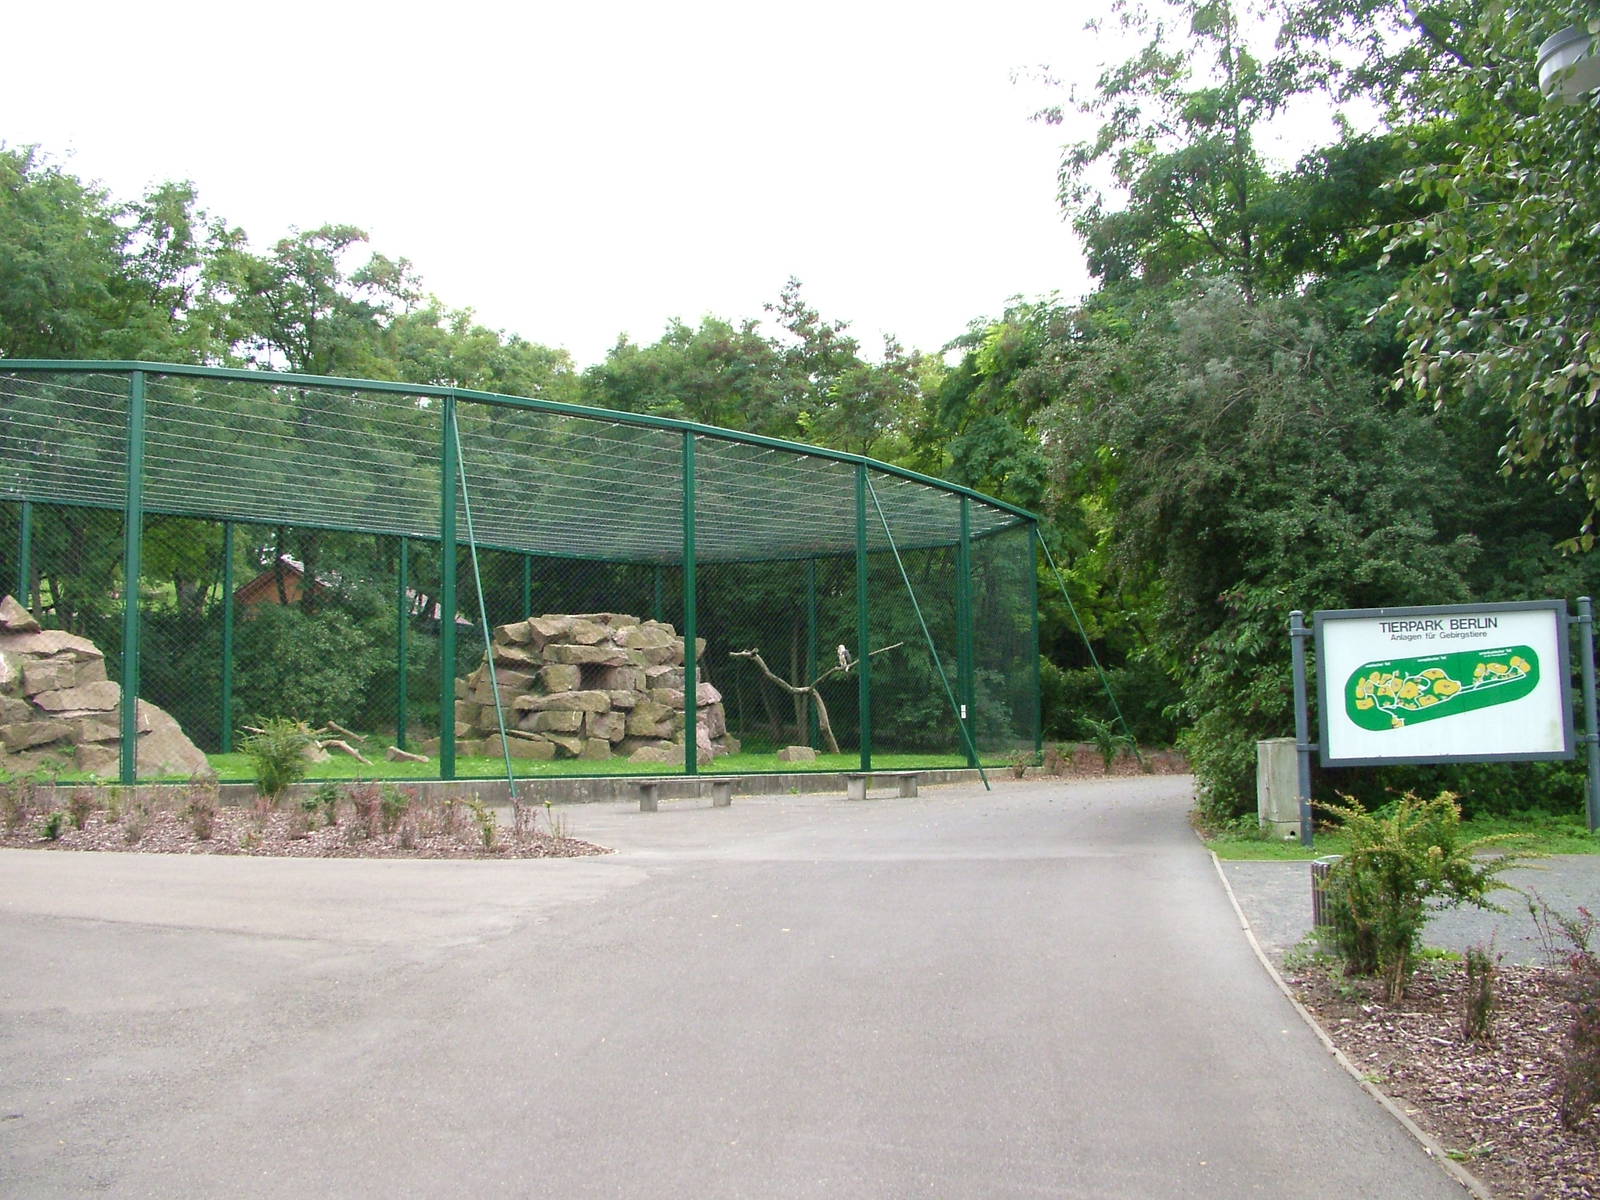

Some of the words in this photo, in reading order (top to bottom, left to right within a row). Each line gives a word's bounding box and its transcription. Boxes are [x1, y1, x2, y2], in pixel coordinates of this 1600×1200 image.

[1379, 619, 1443, 633] TIERPARK
[1450, 617, 1498, 630] BERLIN
[1390, 633, 1422, 641] Anlagen
[1425, 632, 1436, 640] für
[1439, 631, 1488, 640] Gebirgstiere
